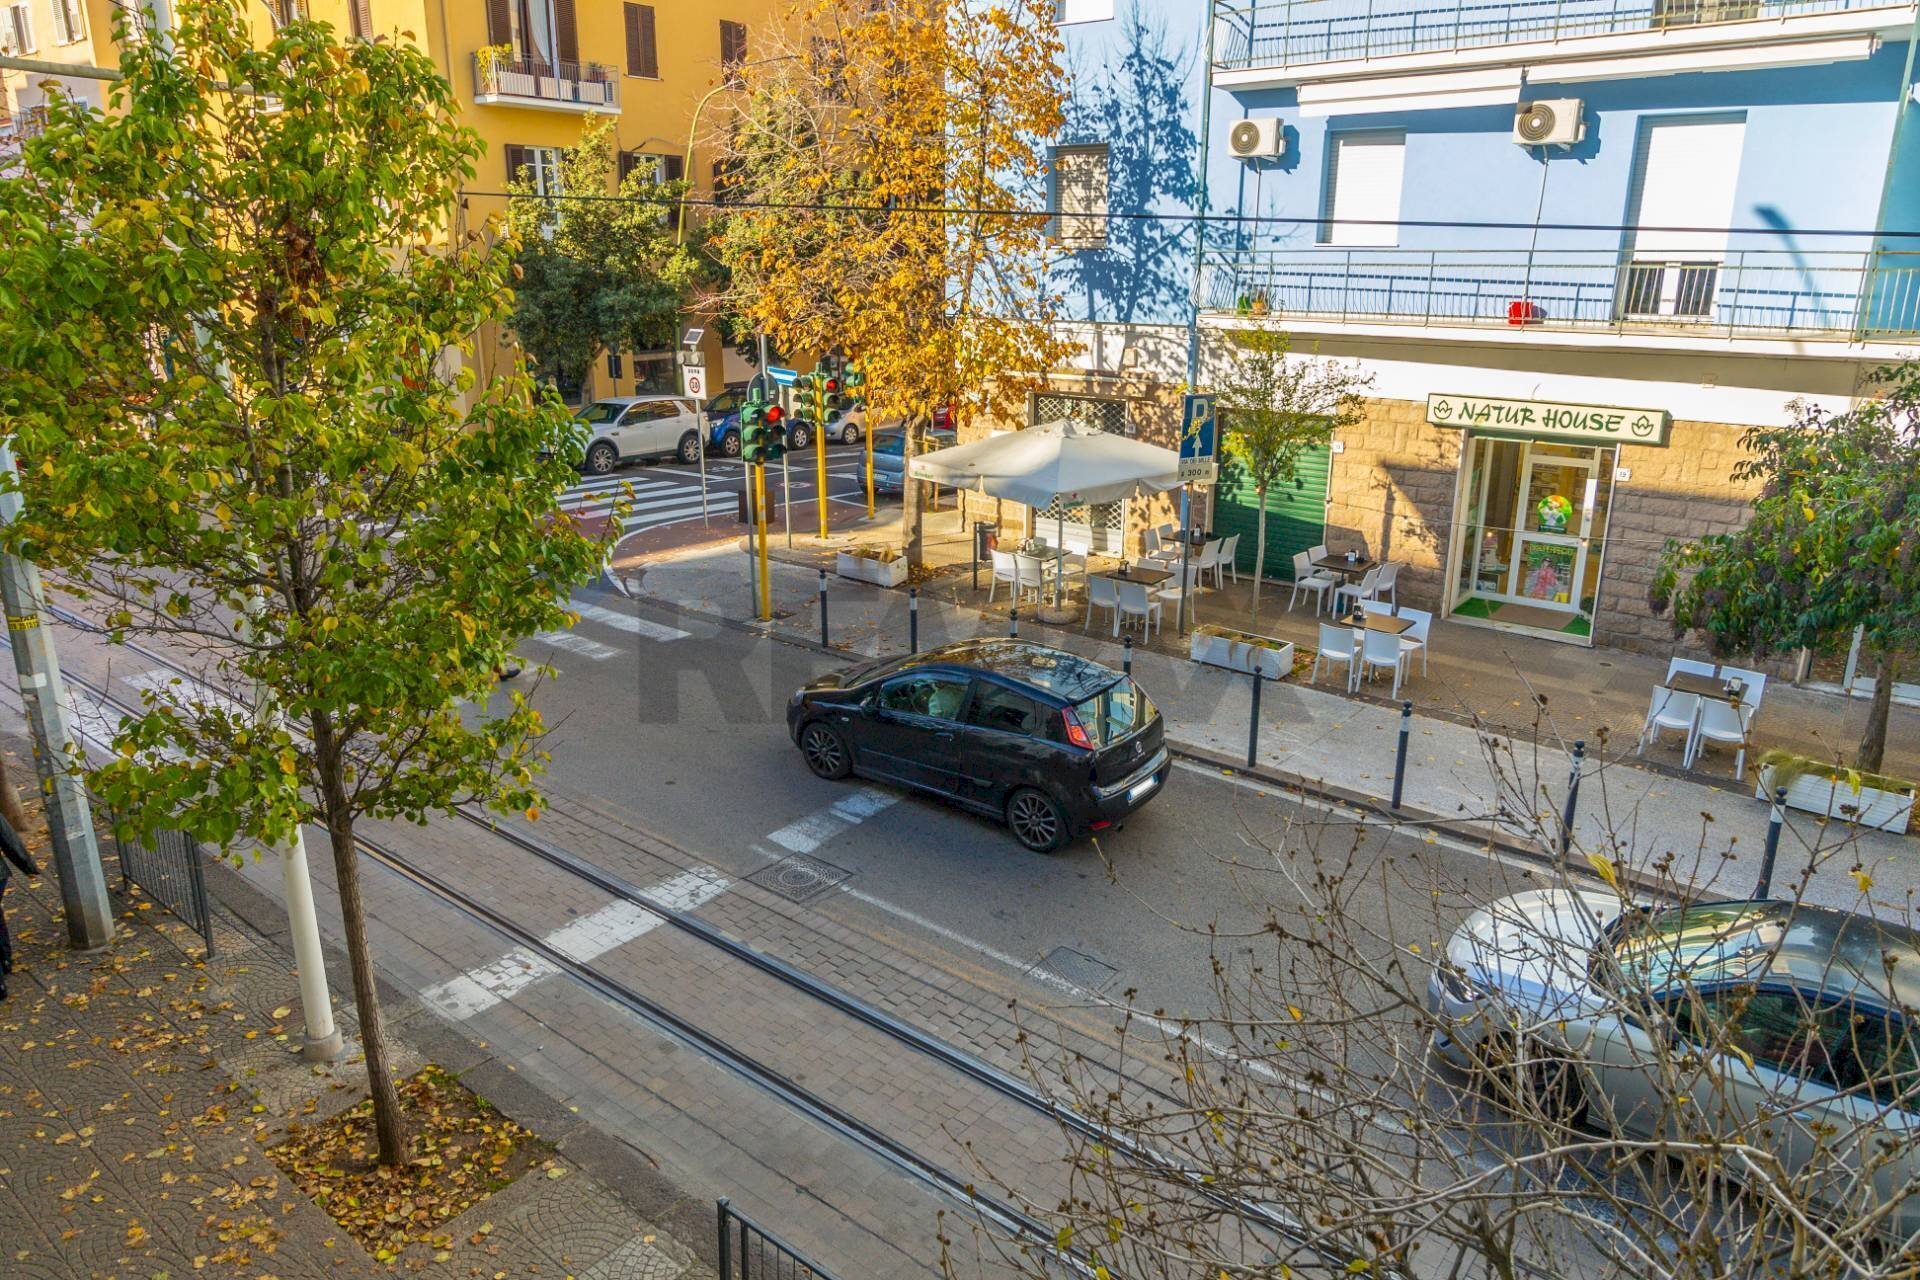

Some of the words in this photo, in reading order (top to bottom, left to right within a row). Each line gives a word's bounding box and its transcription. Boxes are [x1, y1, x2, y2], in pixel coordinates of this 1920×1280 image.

[1458, 401, 1537, 427] NATUR
[1542, 408, 1625, 432] HOUSE
[1187, 468, 1202, 477] 300
